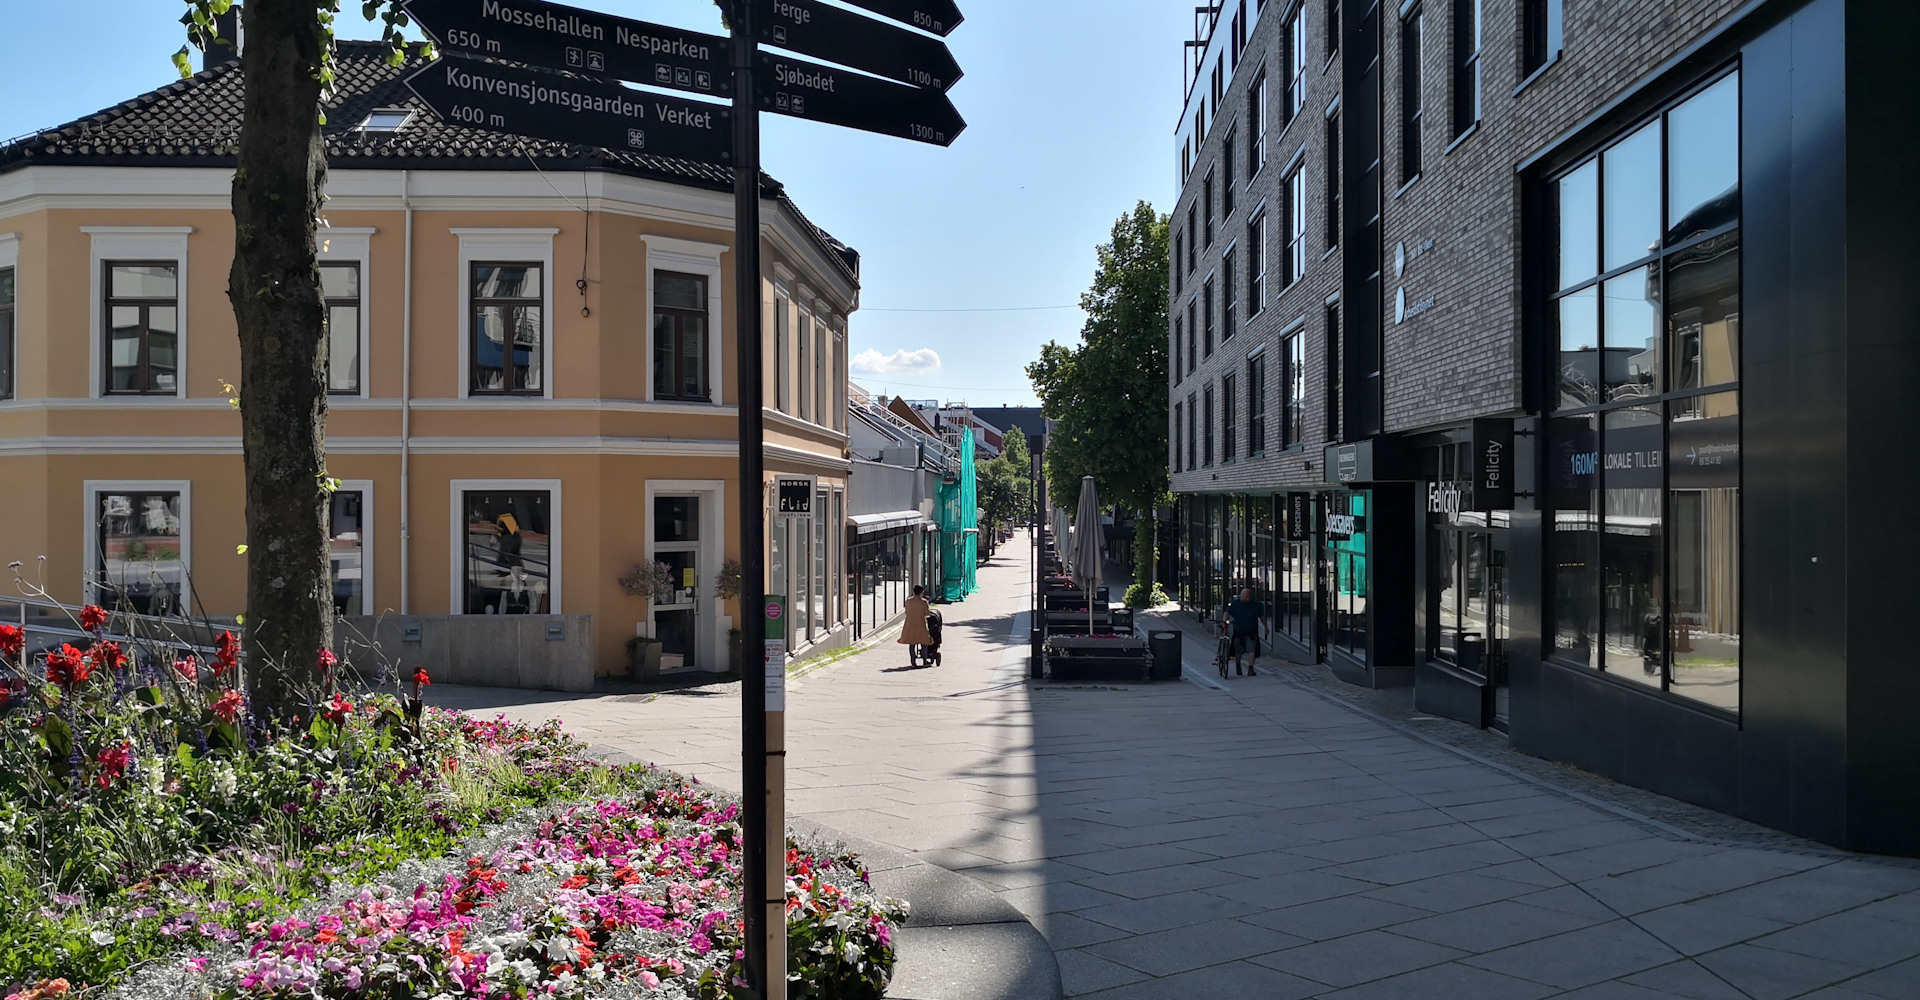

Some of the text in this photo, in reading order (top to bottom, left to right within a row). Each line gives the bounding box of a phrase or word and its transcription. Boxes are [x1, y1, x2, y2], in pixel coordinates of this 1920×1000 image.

[773, 0, 811, 24] Ferge
[913, 10, 942, 32] 850 m
[447, 28, 501, 53] 650 m
[482, 0, 709, 60] Mossehallen Nesparken
[775, 63, 835, 93] Sjøbadet
[907, 68, 941, 89] 1100 m
[446, 66, 712, 130] Konvensjonsgaarden Verket
[450, 104, 505, 127] 400 m
[910, 123, 944, 142] 1300 m
[1485, 439, 1503, 489] Felicity
[1604, 452, 1632, 470] LOKALE
[1634, 451, 1646, 469] TIL
[1427, 480, 1461, 523] Felicity
[1292, 495, 1303, 538] Specsavers
[1324, 506, 1356, 538] Specsavers
